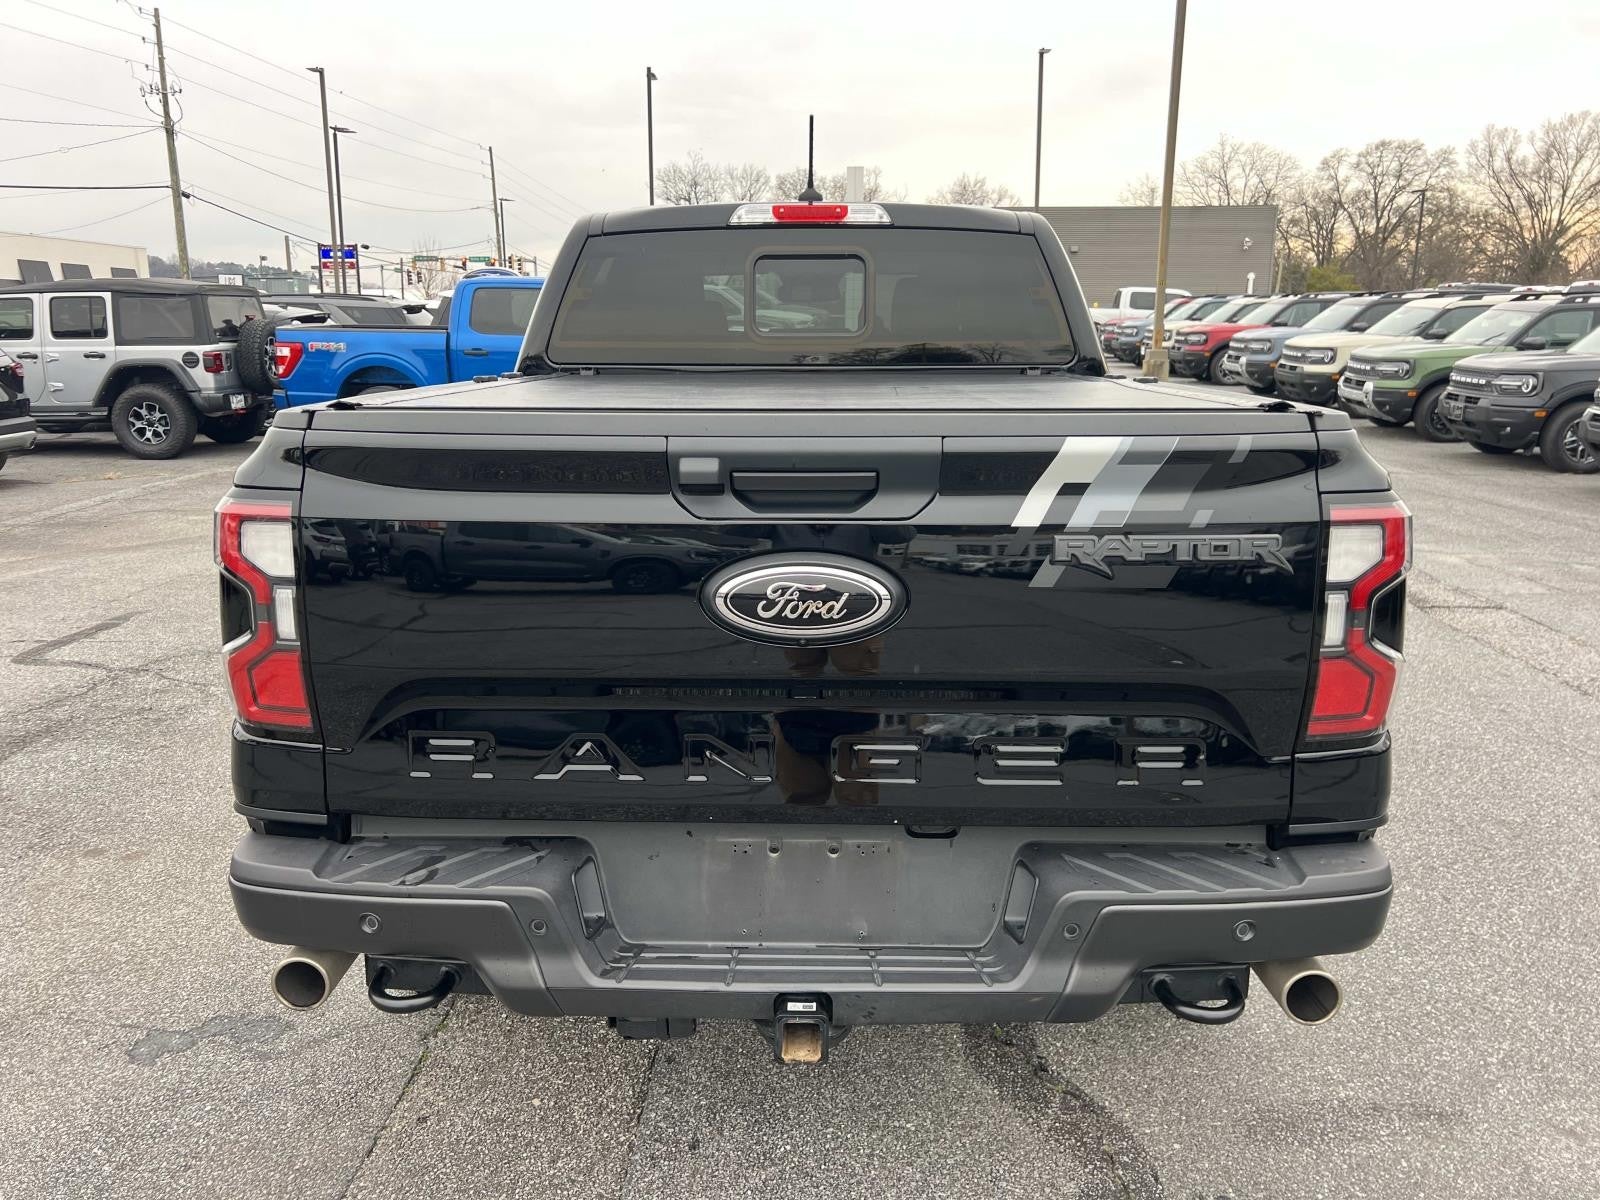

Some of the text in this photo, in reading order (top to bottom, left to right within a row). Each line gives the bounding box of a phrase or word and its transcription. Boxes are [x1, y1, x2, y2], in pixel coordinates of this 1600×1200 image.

[1053, 534, 1295, 578] RAPTOR
[757, 581, 850, 619] Ford
[407, 730, 1207, 786] RANGER
